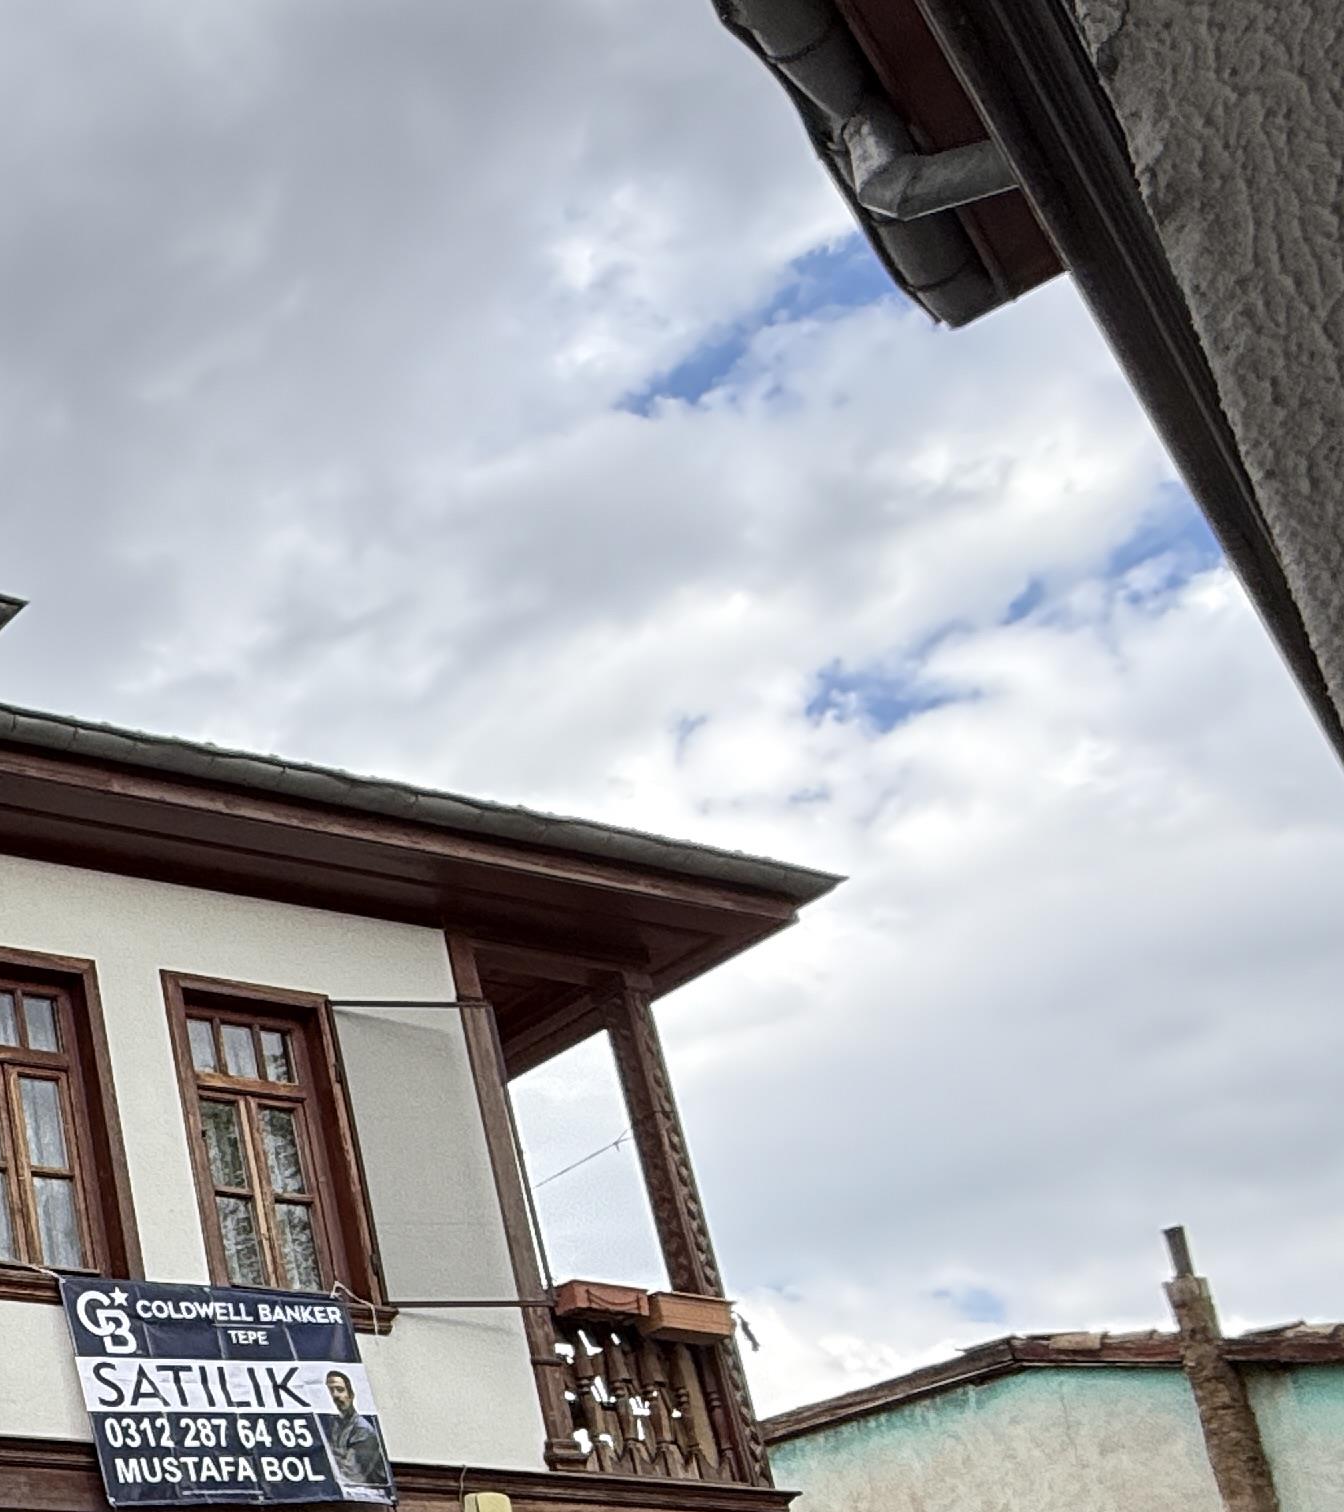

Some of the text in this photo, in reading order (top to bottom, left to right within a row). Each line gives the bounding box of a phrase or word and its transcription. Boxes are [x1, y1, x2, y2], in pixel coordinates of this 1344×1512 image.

[136, 1300, 343, 1325] COLDWELL BANKER
[227, 1329, 270, 1346] TEPE
[92, 1361, 312, 1408] SATILIK
[105, 1418, 313, 1449] 0312 287 64 65
[114, 1456, 326, 1484] MUSTAFA BOL
